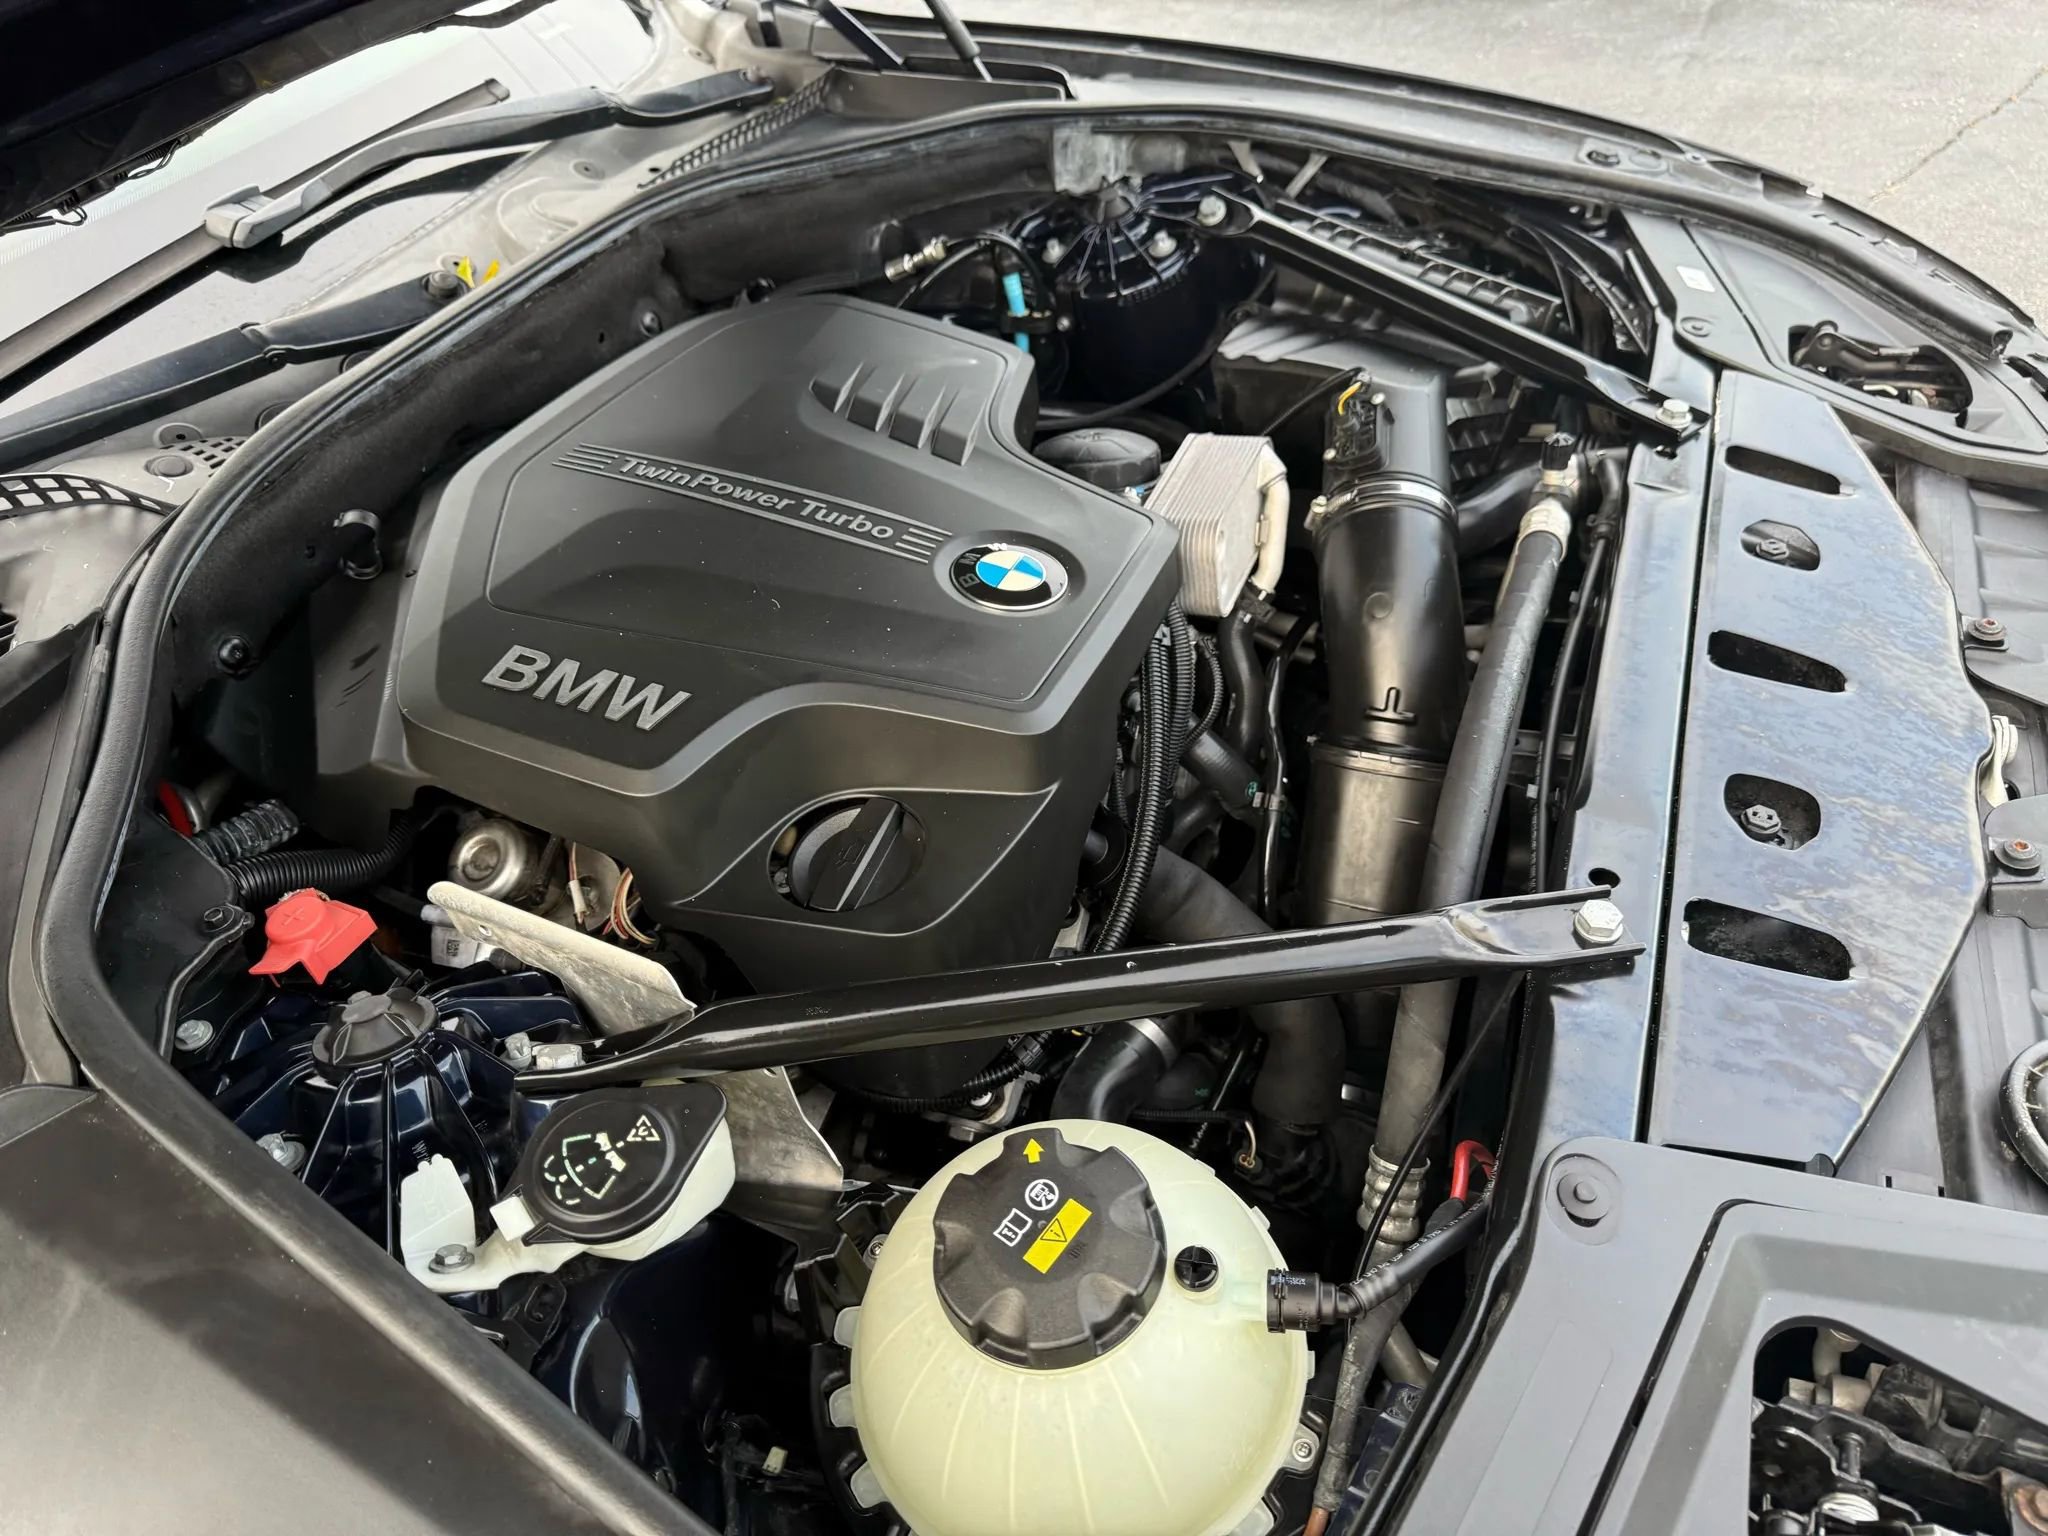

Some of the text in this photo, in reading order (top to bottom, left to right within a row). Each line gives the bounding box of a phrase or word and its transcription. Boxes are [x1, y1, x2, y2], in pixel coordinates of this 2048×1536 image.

[618, 456, 894, 539] TwinPower Turbo
[959, 542, 1008, 588] BMW
[481, 644, 693, 731] BMW
